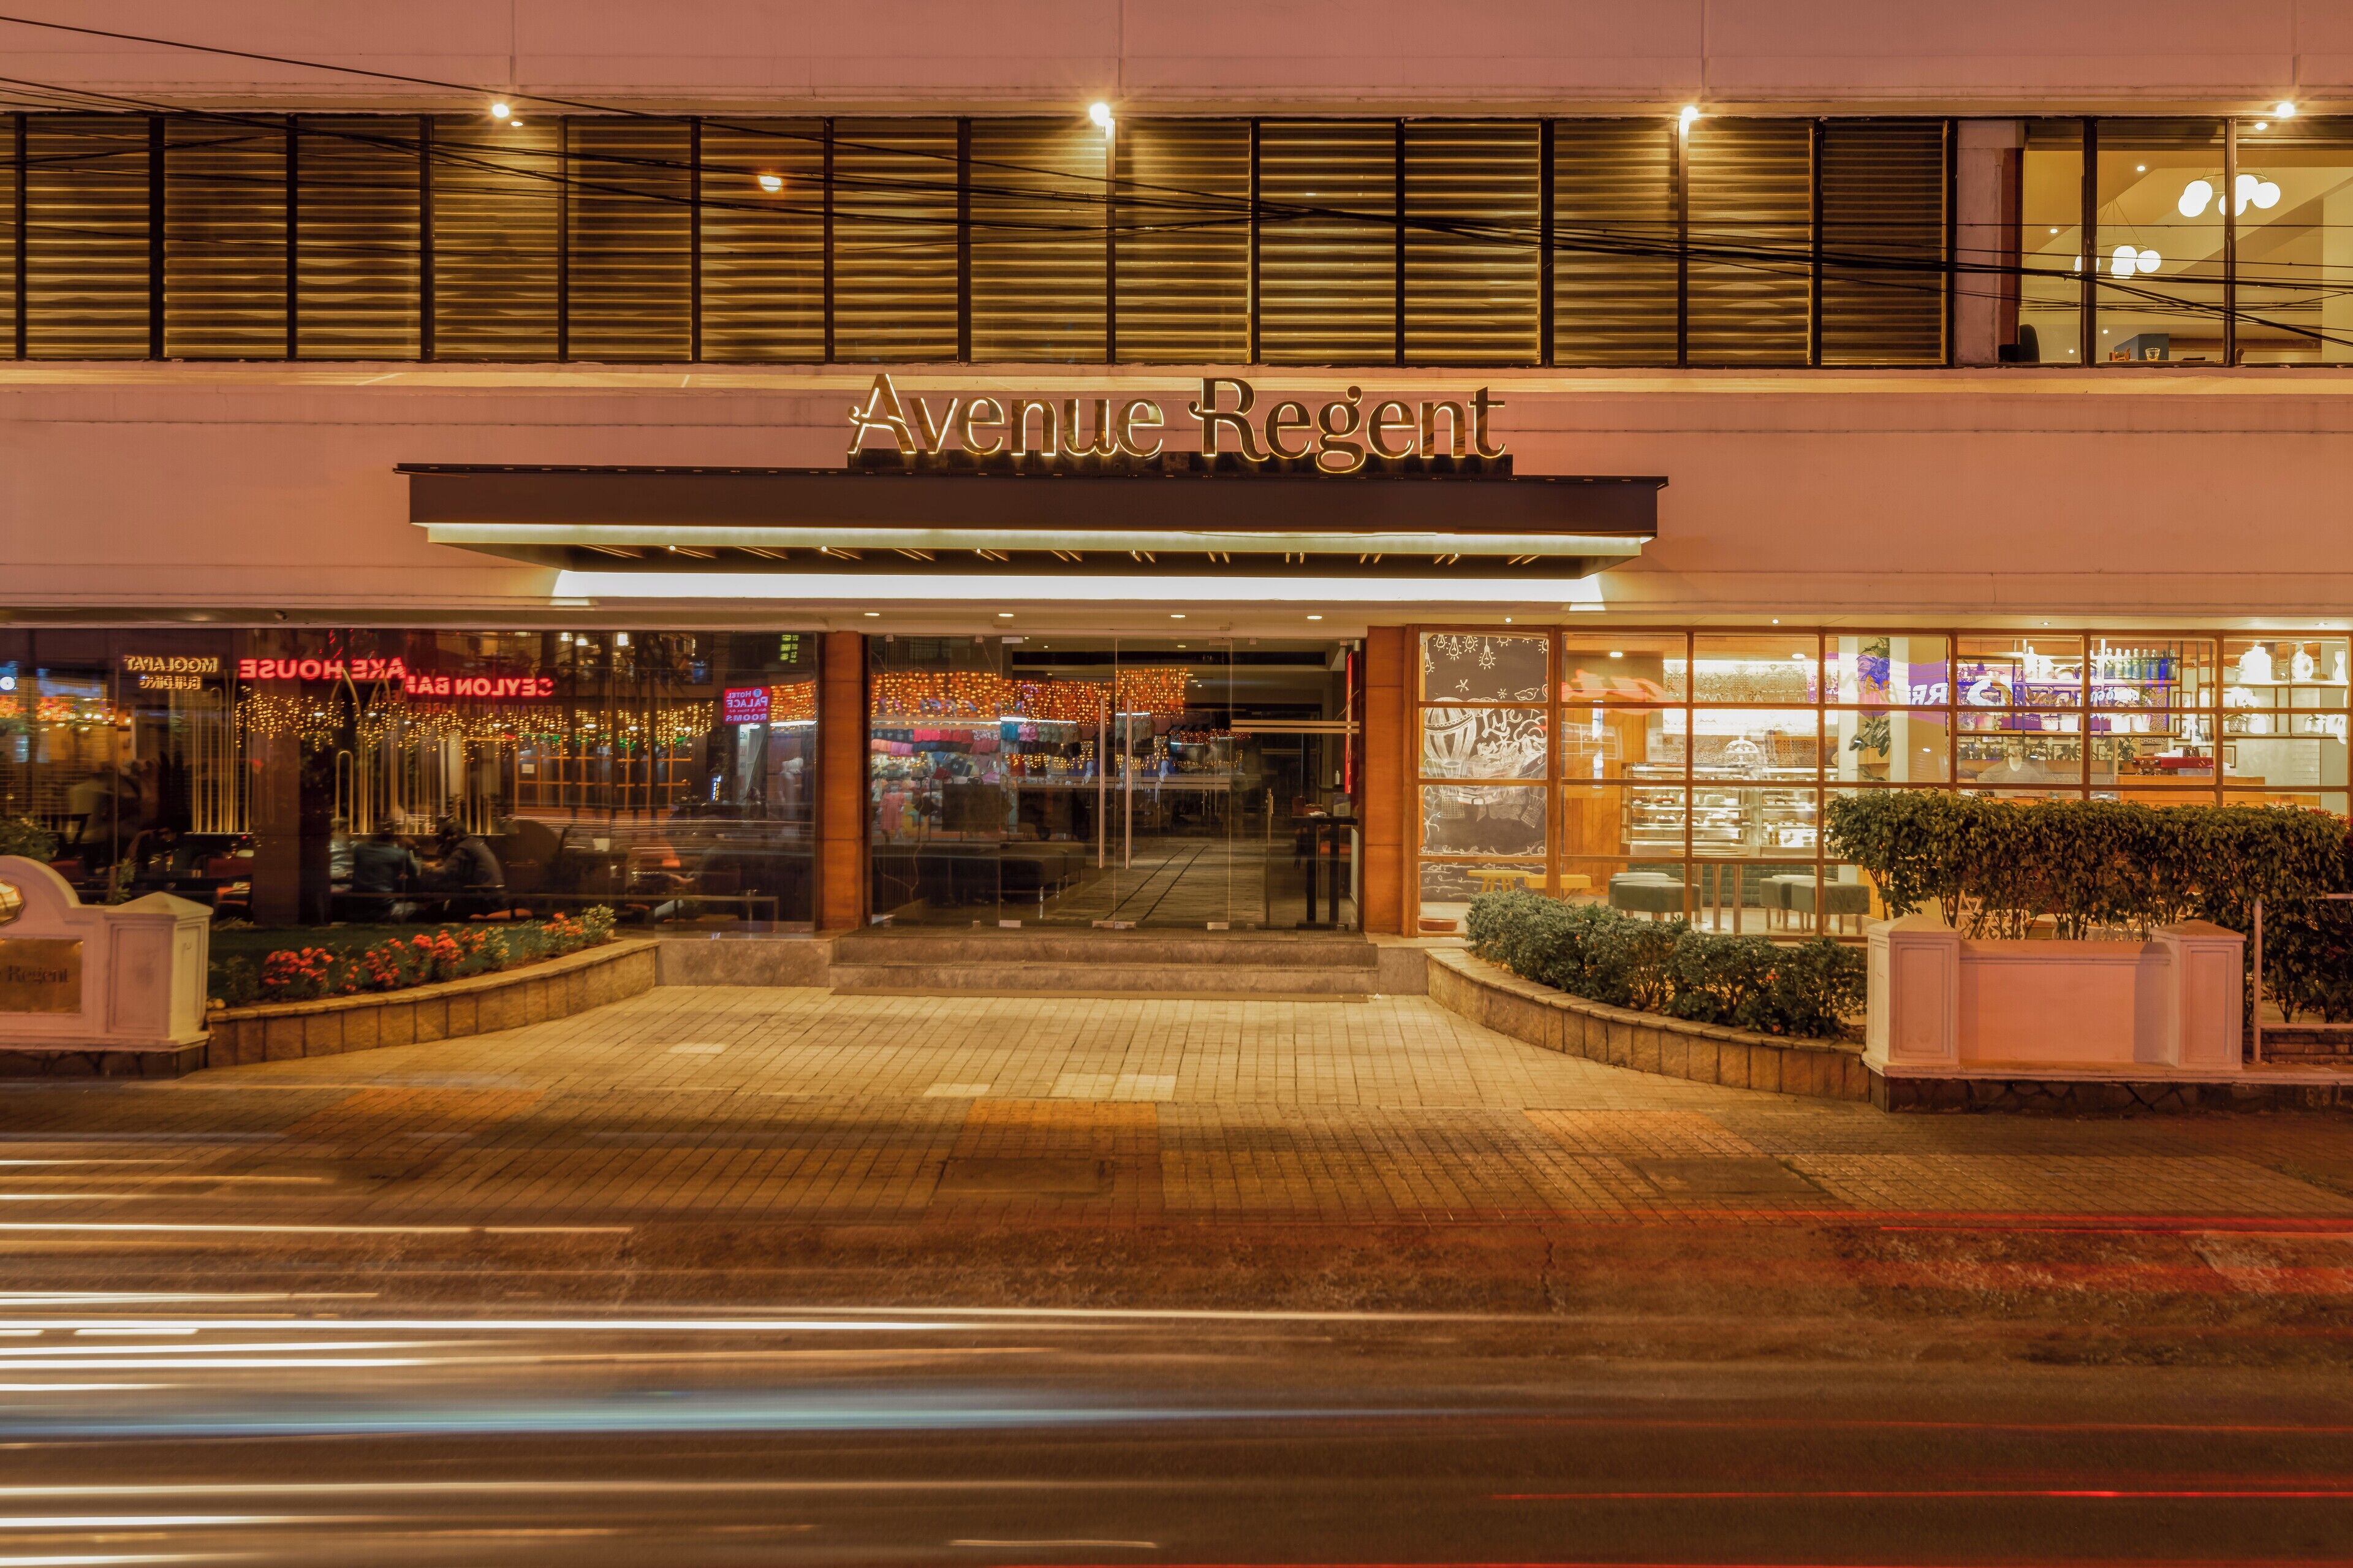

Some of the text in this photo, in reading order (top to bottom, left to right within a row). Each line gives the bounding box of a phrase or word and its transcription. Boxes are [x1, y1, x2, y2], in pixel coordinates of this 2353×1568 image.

[848, 373, 1507, 474] Avenue Regent
[7, 964, 69, 985] Regent
